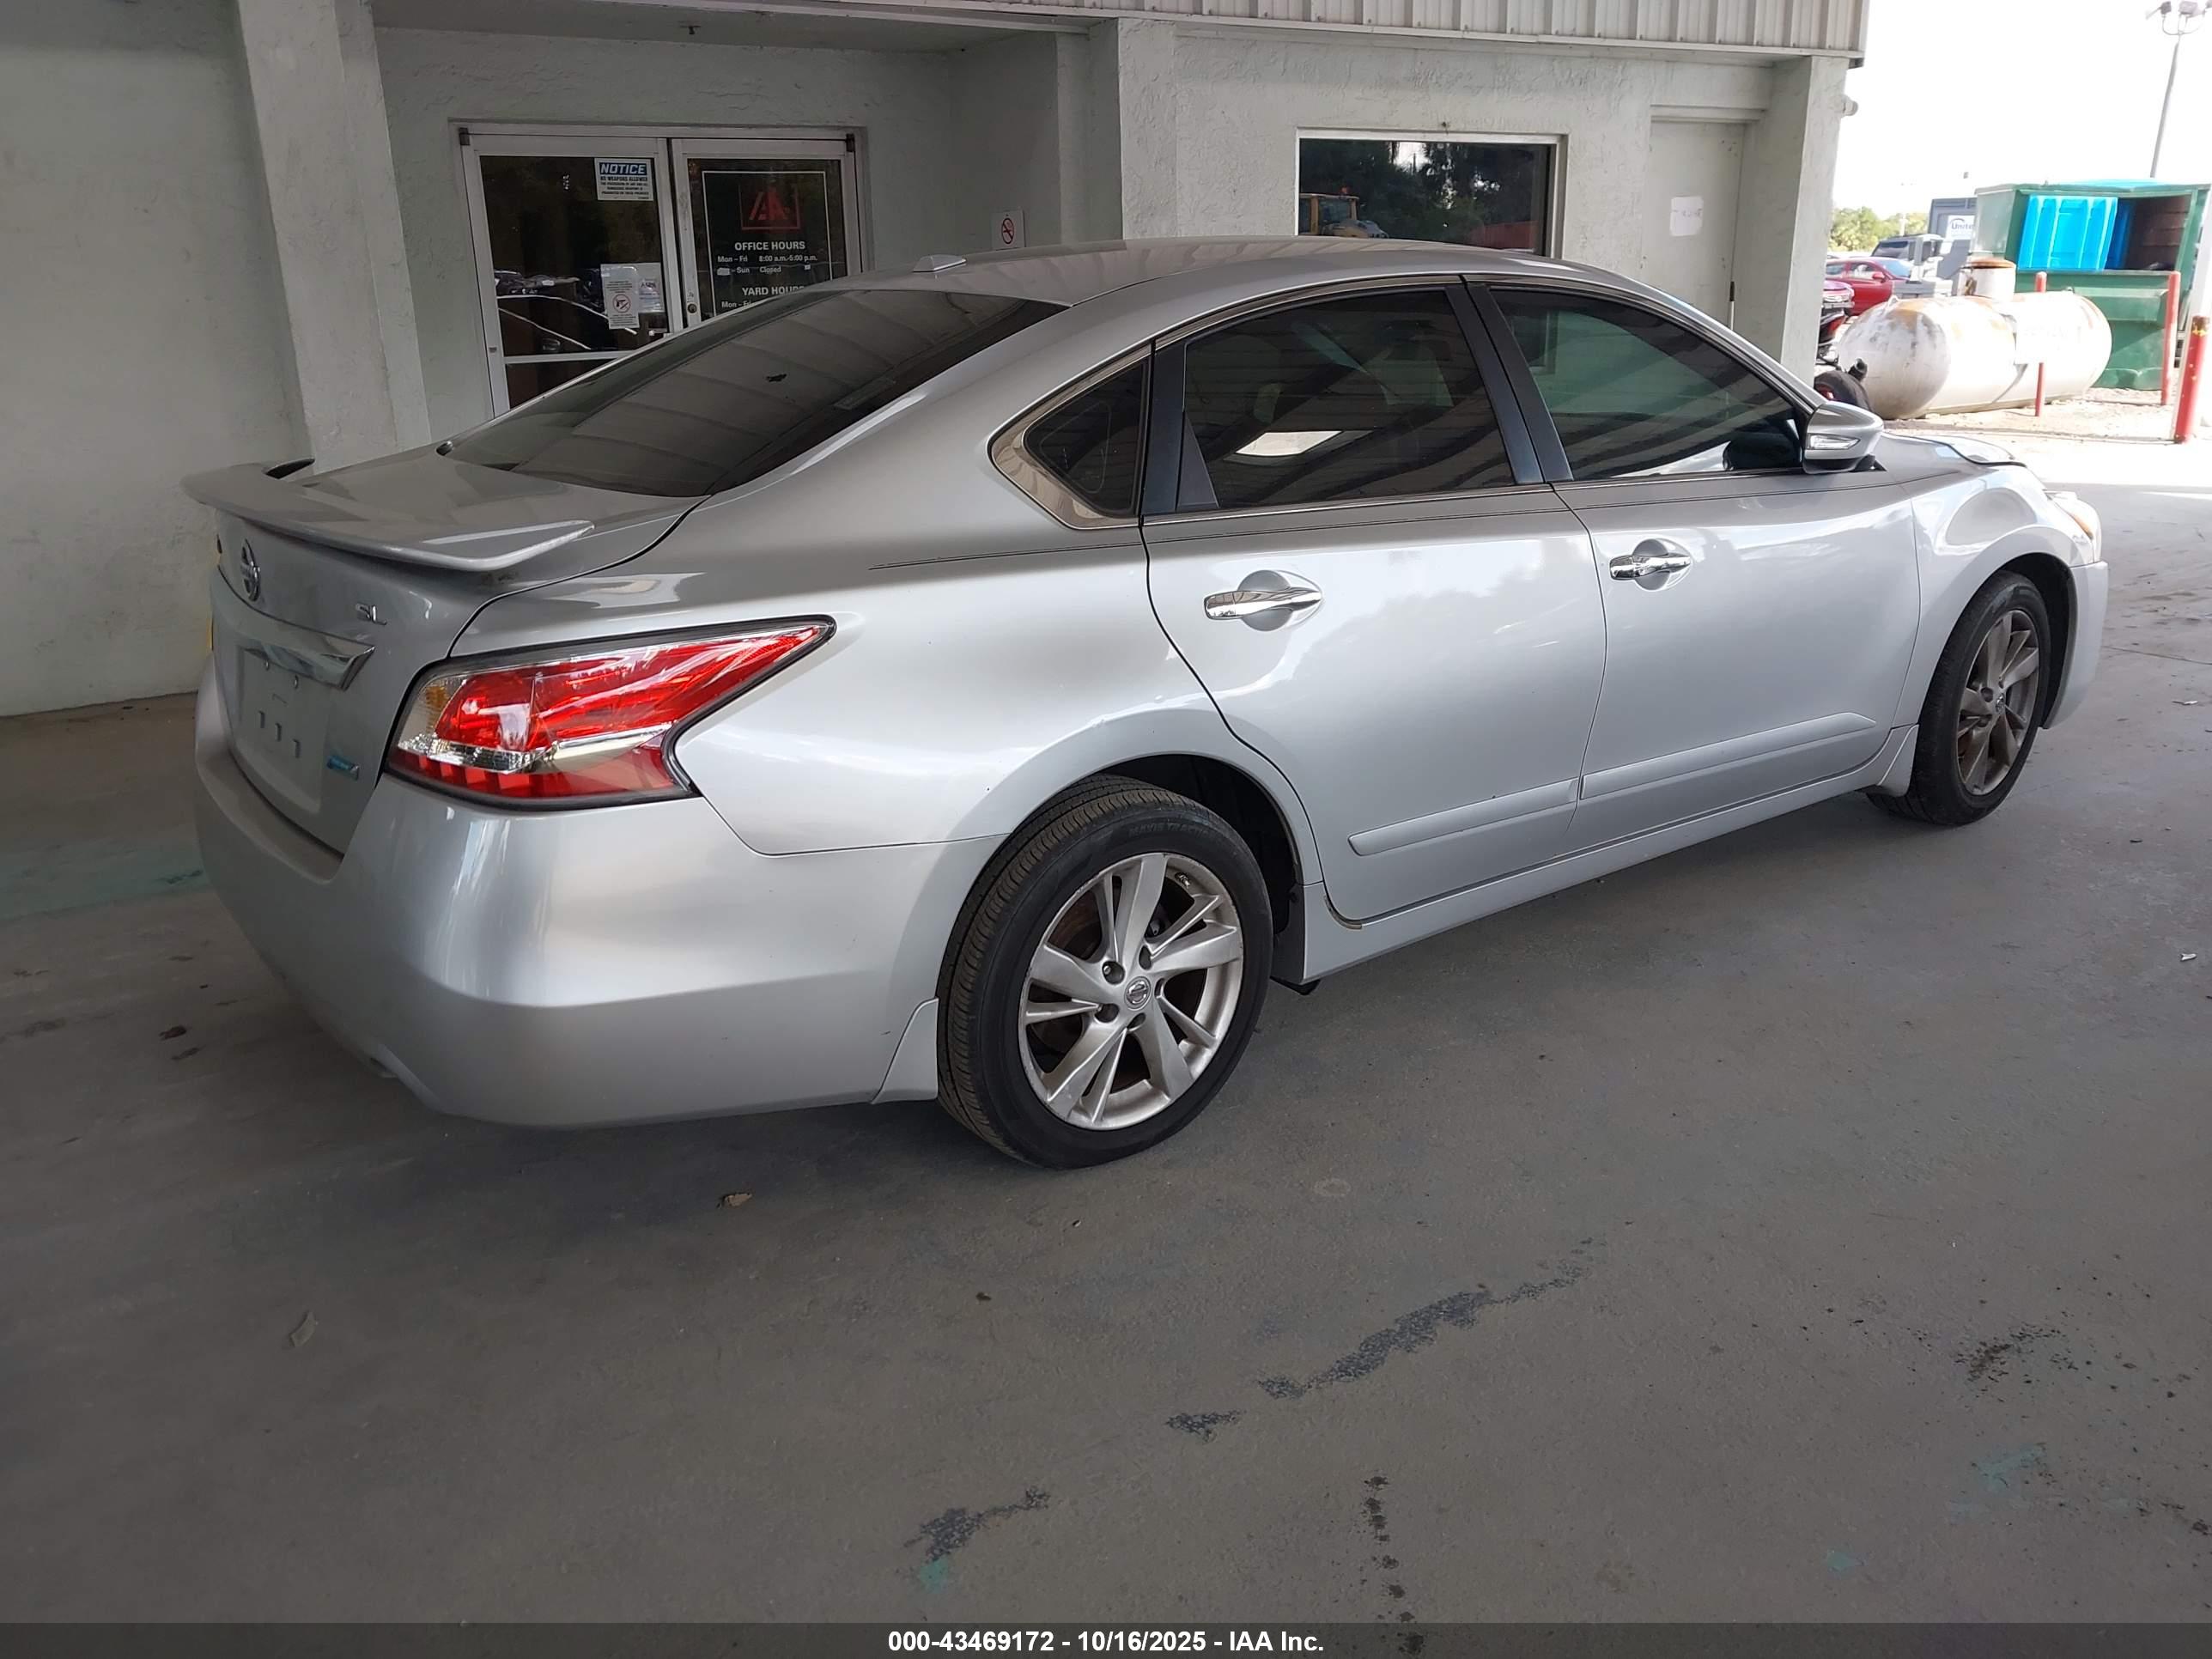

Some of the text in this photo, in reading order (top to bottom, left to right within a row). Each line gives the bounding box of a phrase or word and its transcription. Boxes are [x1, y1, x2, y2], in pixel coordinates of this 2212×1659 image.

[600, 163, 646, 174] NOTICE
[734, 240, 806, 251] OFFICE HOURS
[759, 265, 781, 274] Closed
[742, 287, 769, 296] YARD
[356, 603, 387, 626] SL
